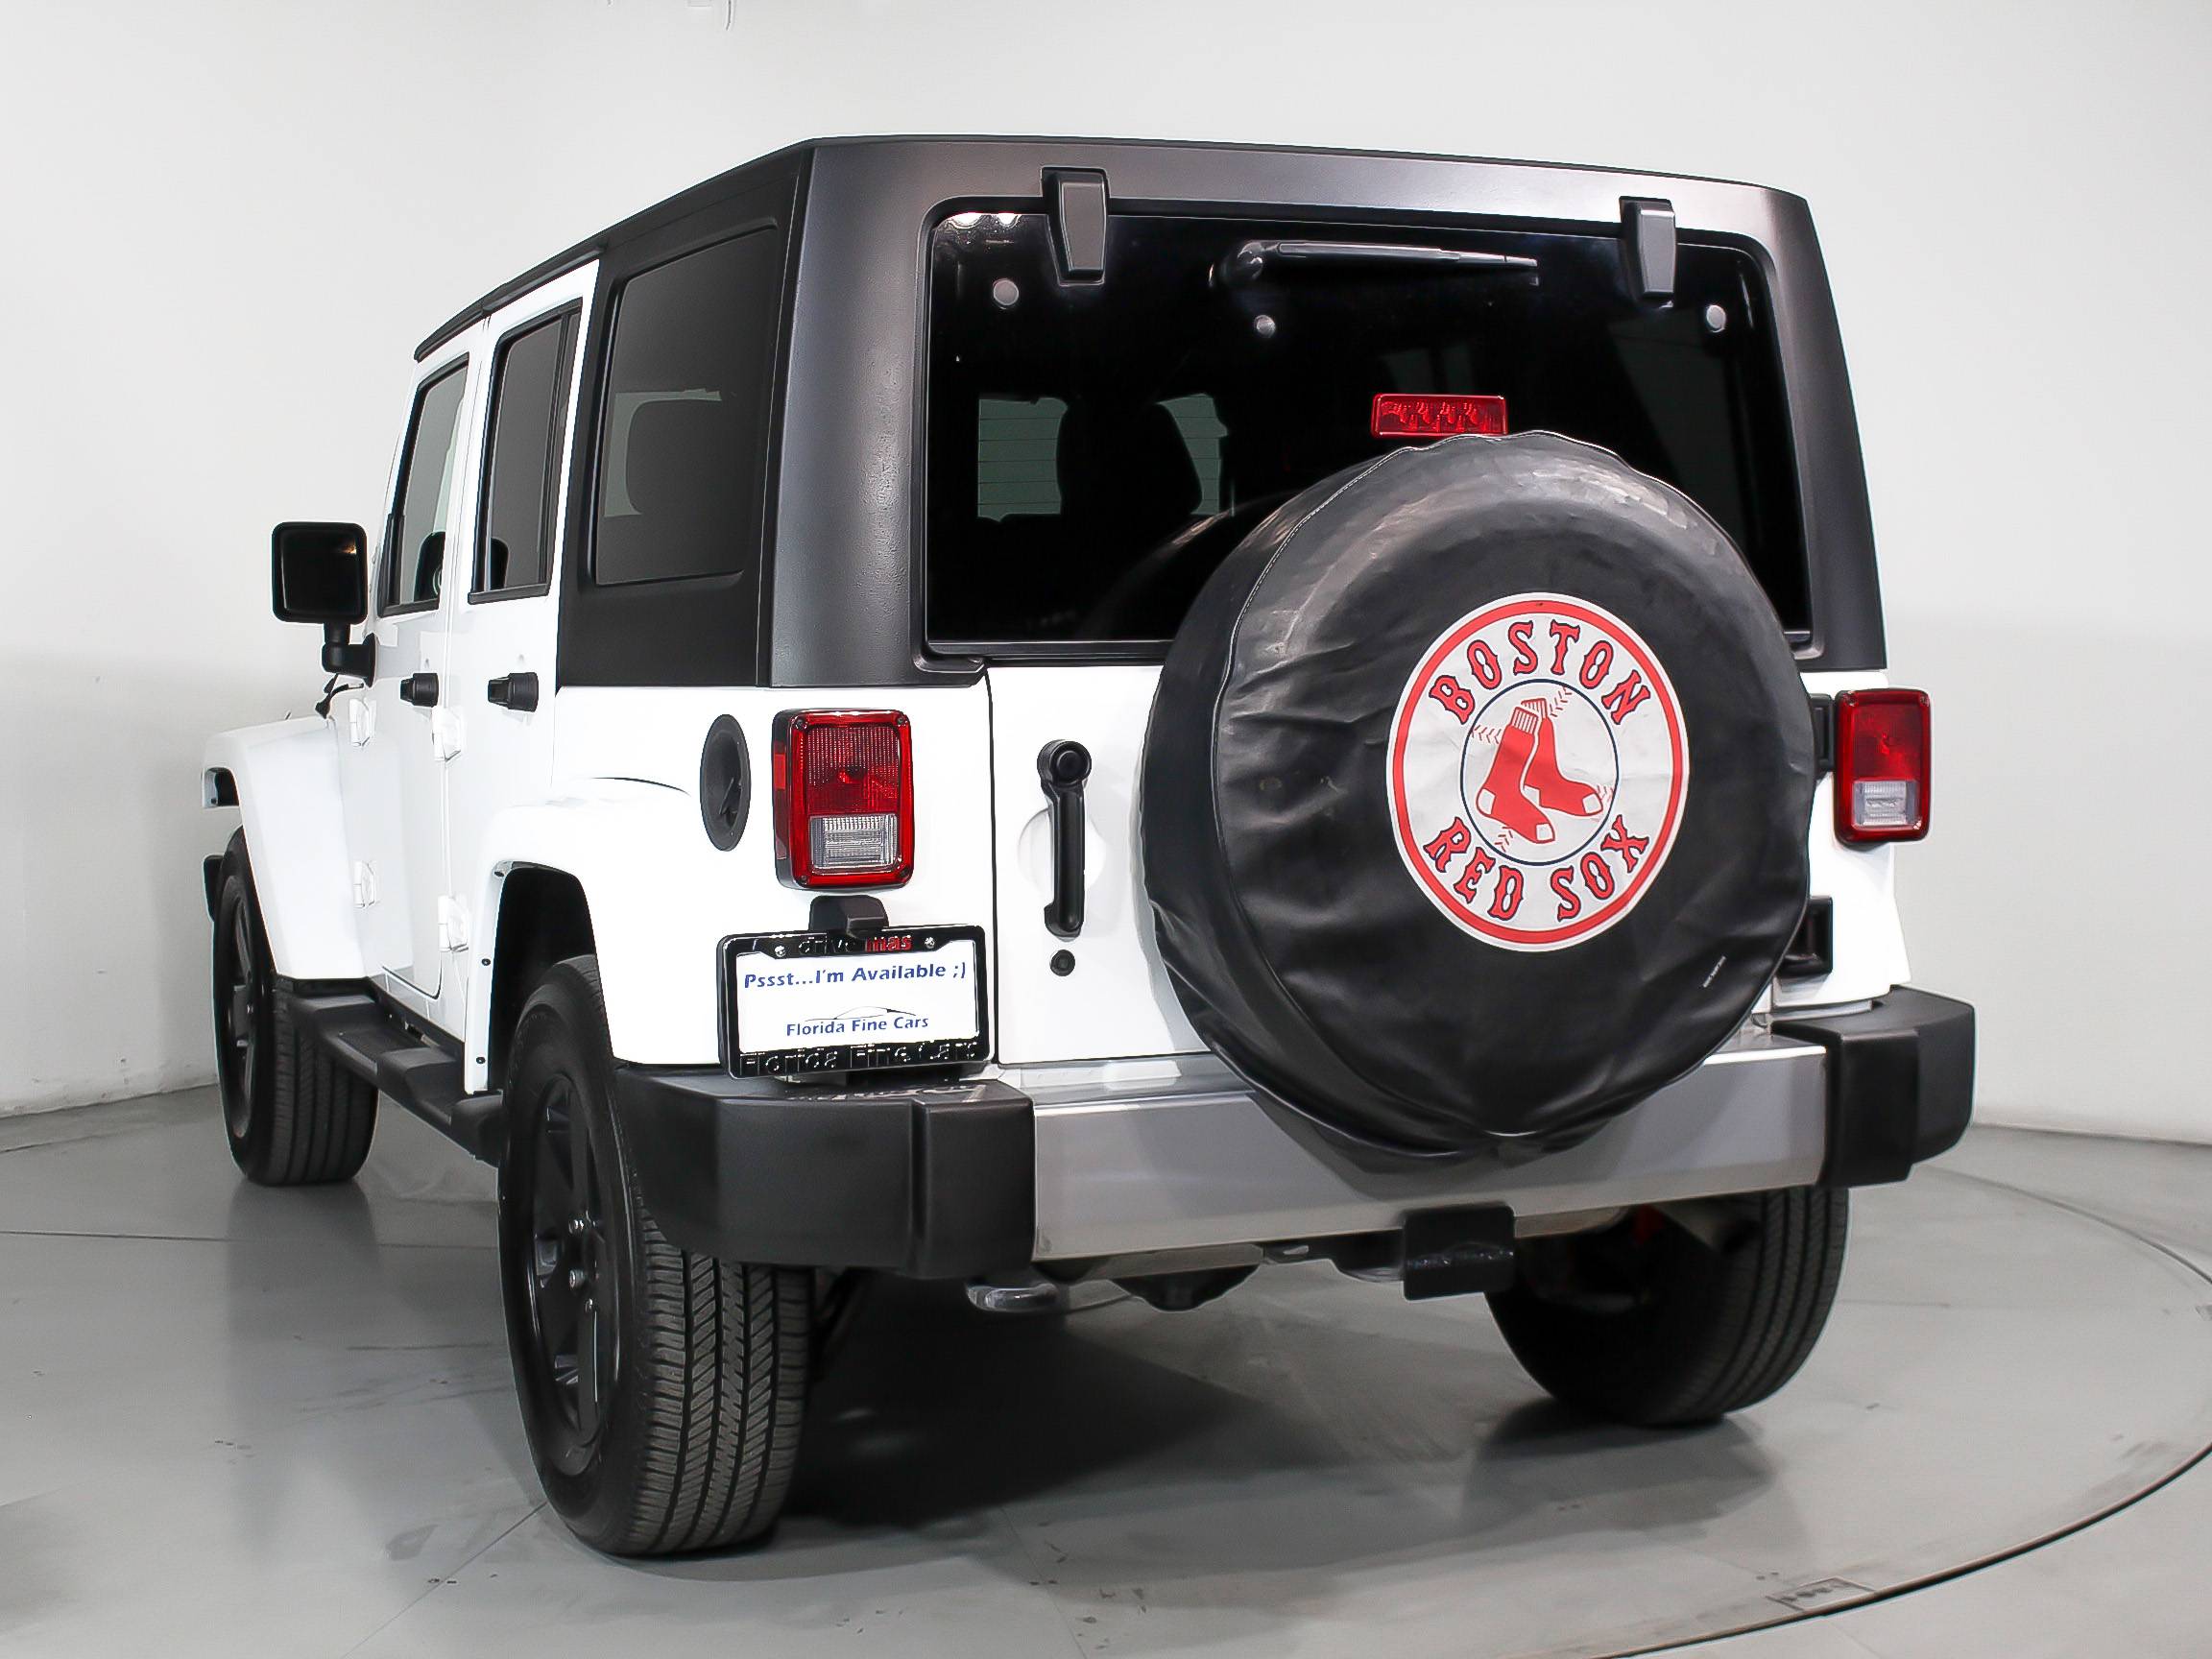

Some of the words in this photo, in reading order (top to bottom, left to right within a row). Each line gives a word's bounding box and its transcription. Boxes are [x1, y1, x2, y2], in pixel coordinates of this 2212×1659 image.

[1429, 619, 1651, 725] BOSTON
[1423, 816, 1525, 921] RED
[1550, 814, 1650, 922] SOX
[852, 963, 947, 982] Available
[785, 1020, 846, 1037] Florida
[851, 1020, 888, 1033] Fine
[893, 1015, 929, 1030] Cars
